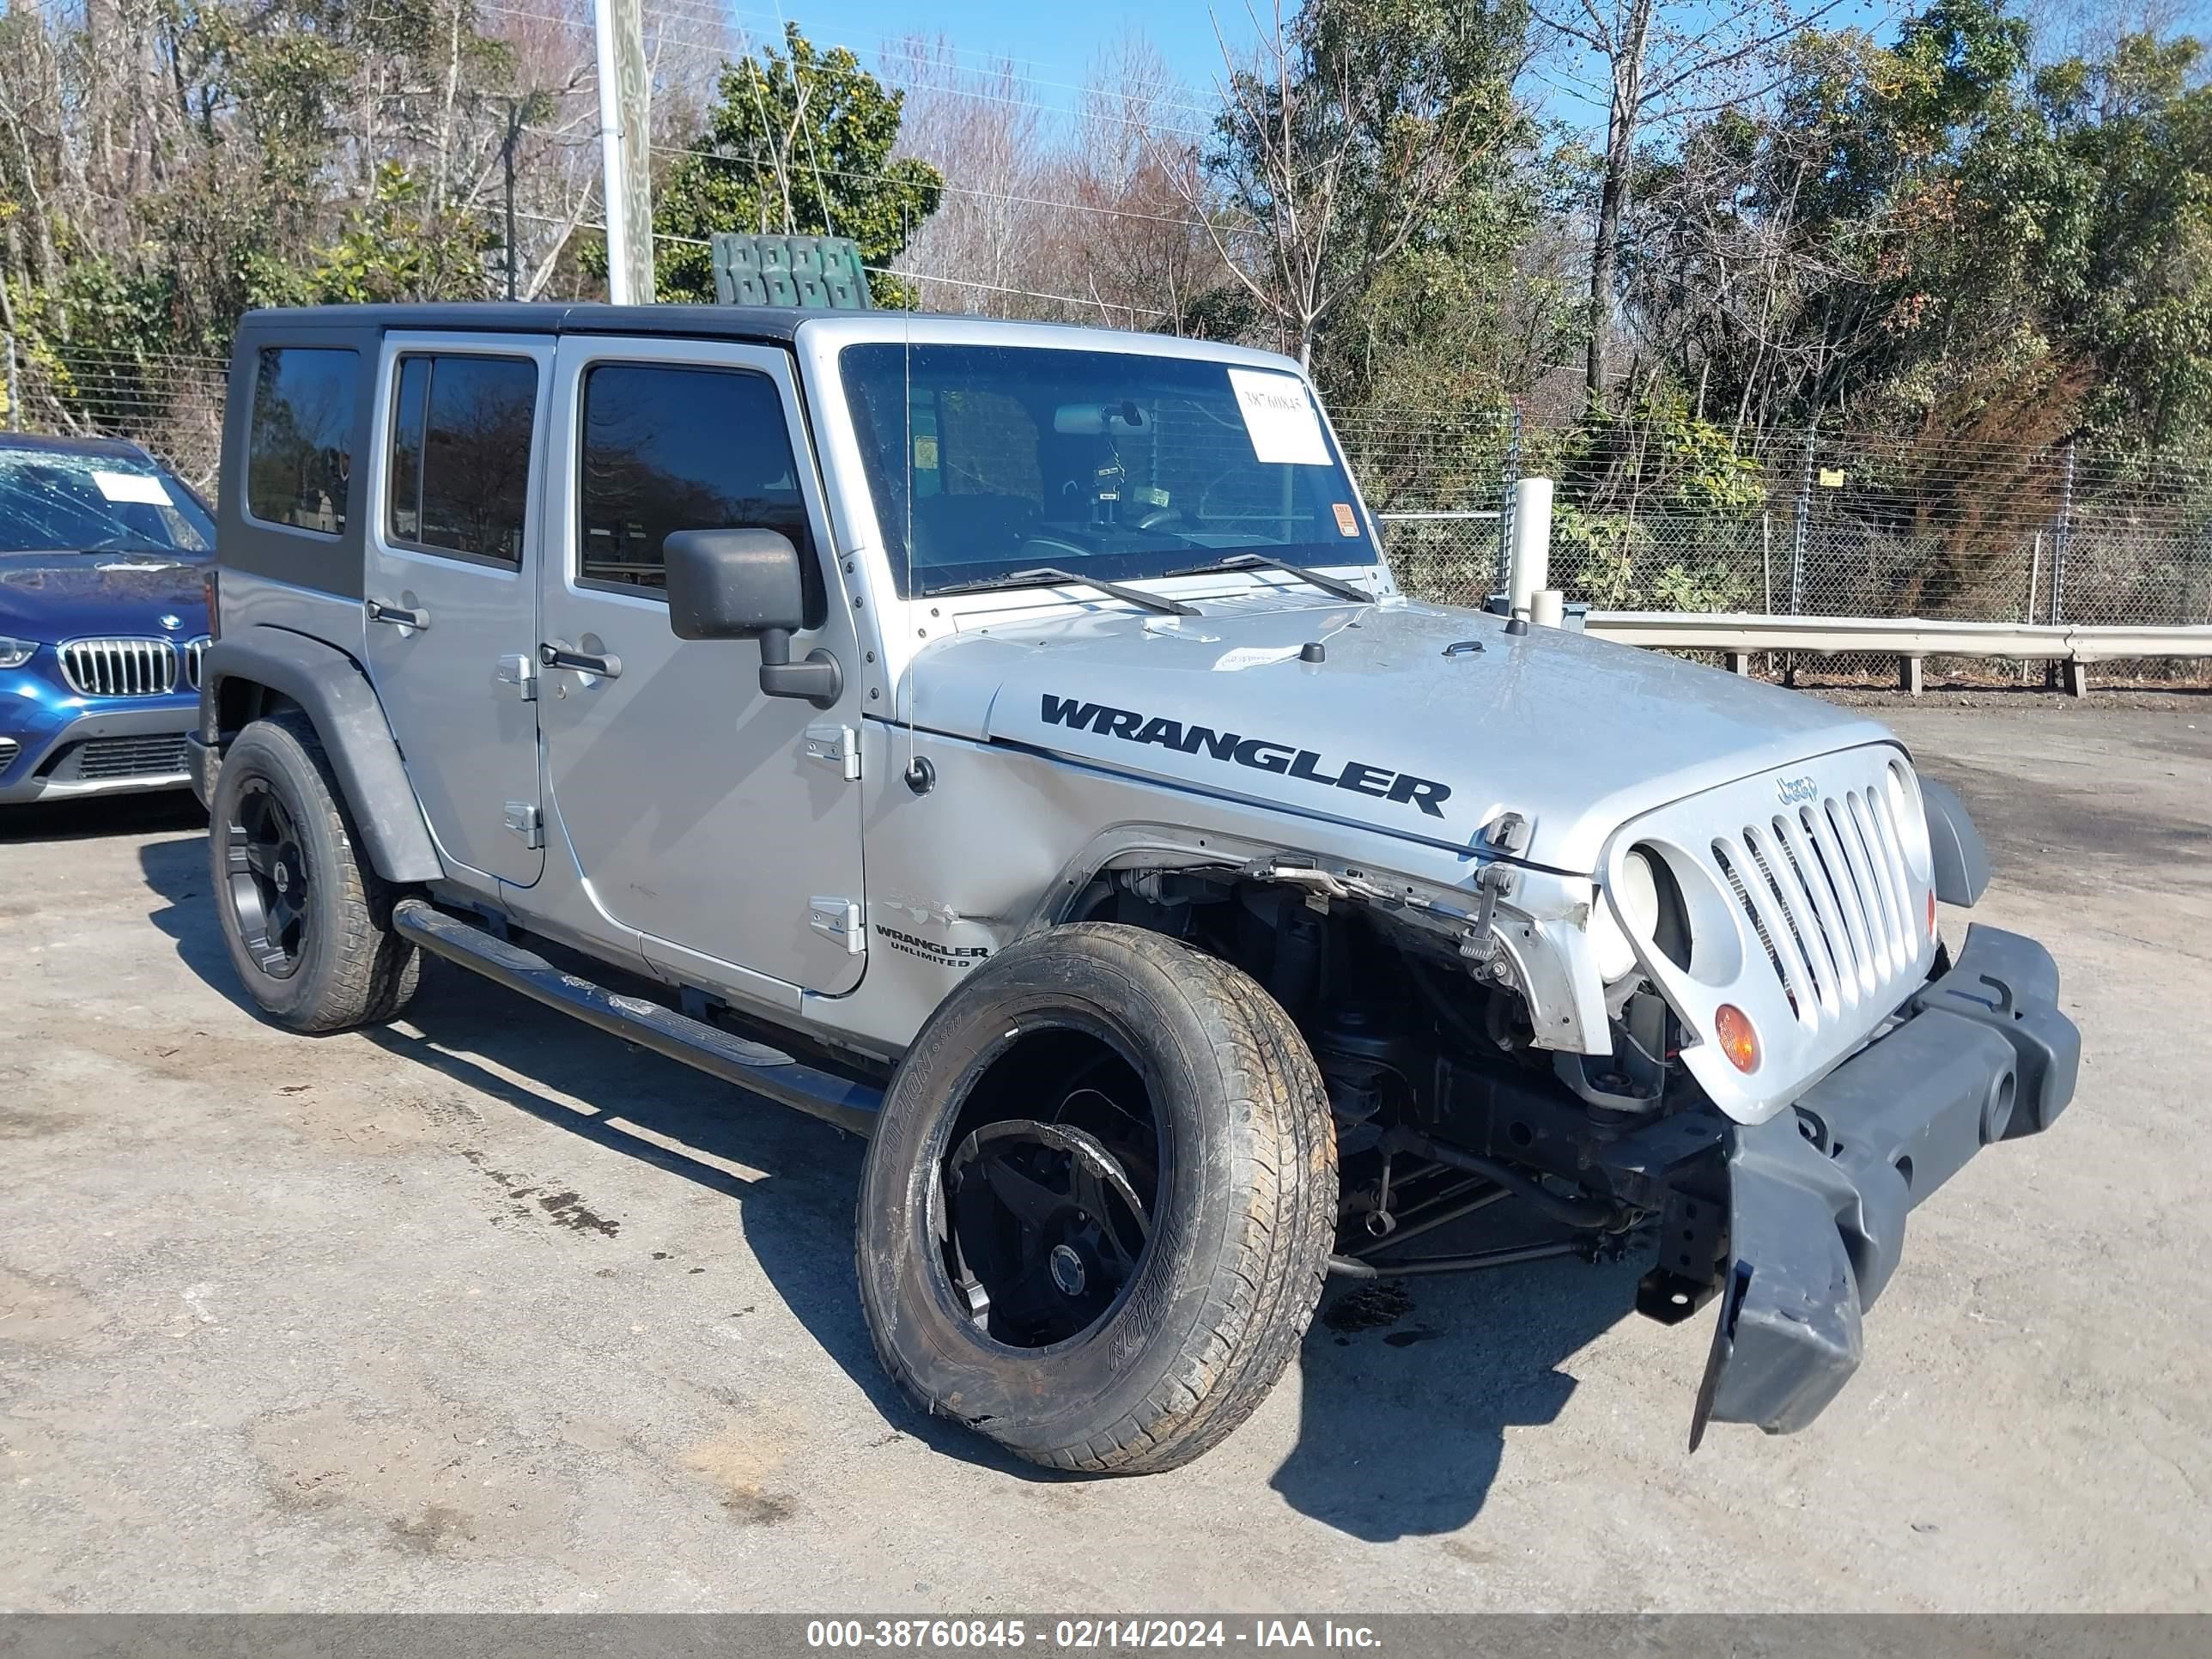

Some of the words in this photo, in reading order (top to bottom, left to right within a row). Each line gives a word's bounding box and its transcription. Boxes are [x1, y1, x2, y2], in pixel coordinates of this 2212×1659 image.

[1041, 693, 1452, 820] WRANGLER
[1776, 775, 1817, 805] Jeep
[875, 924, 989, 958] WRANGLER
[890, 941, 970, 969] UNLIMITED
[883, 1048, 933, 1175] FUZION
